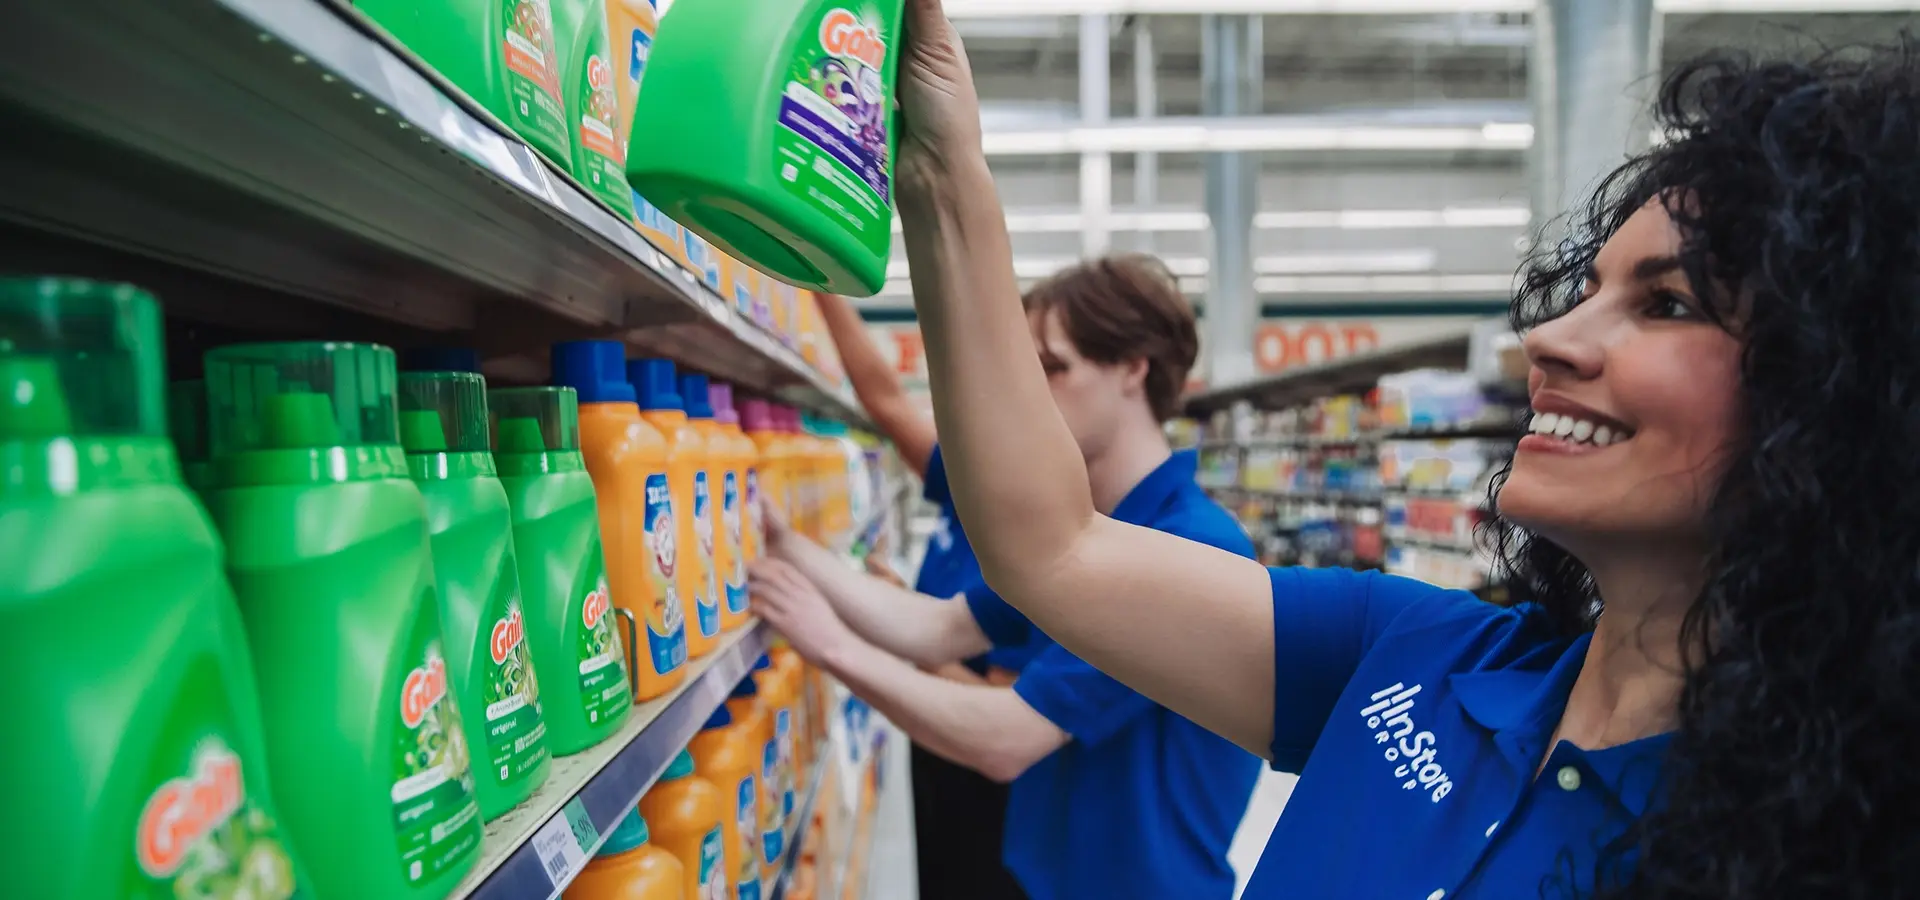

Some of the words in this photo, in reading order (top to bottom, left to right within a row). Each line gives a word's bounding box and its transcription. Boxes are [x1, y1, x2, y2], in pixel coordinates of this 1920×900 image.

[588, 54, 613, 90] Gai
[820, 9, 886, 71] Gain
[491, 611, 523, 665] Gain
[401, 658, 446, 729] Gain
[491, 718, 517, 736] original
[1367, 715, 1417, 791] GROUP
[1380, 698, 1453, 803] InStore
[139, 754, 243, 877] Gain
